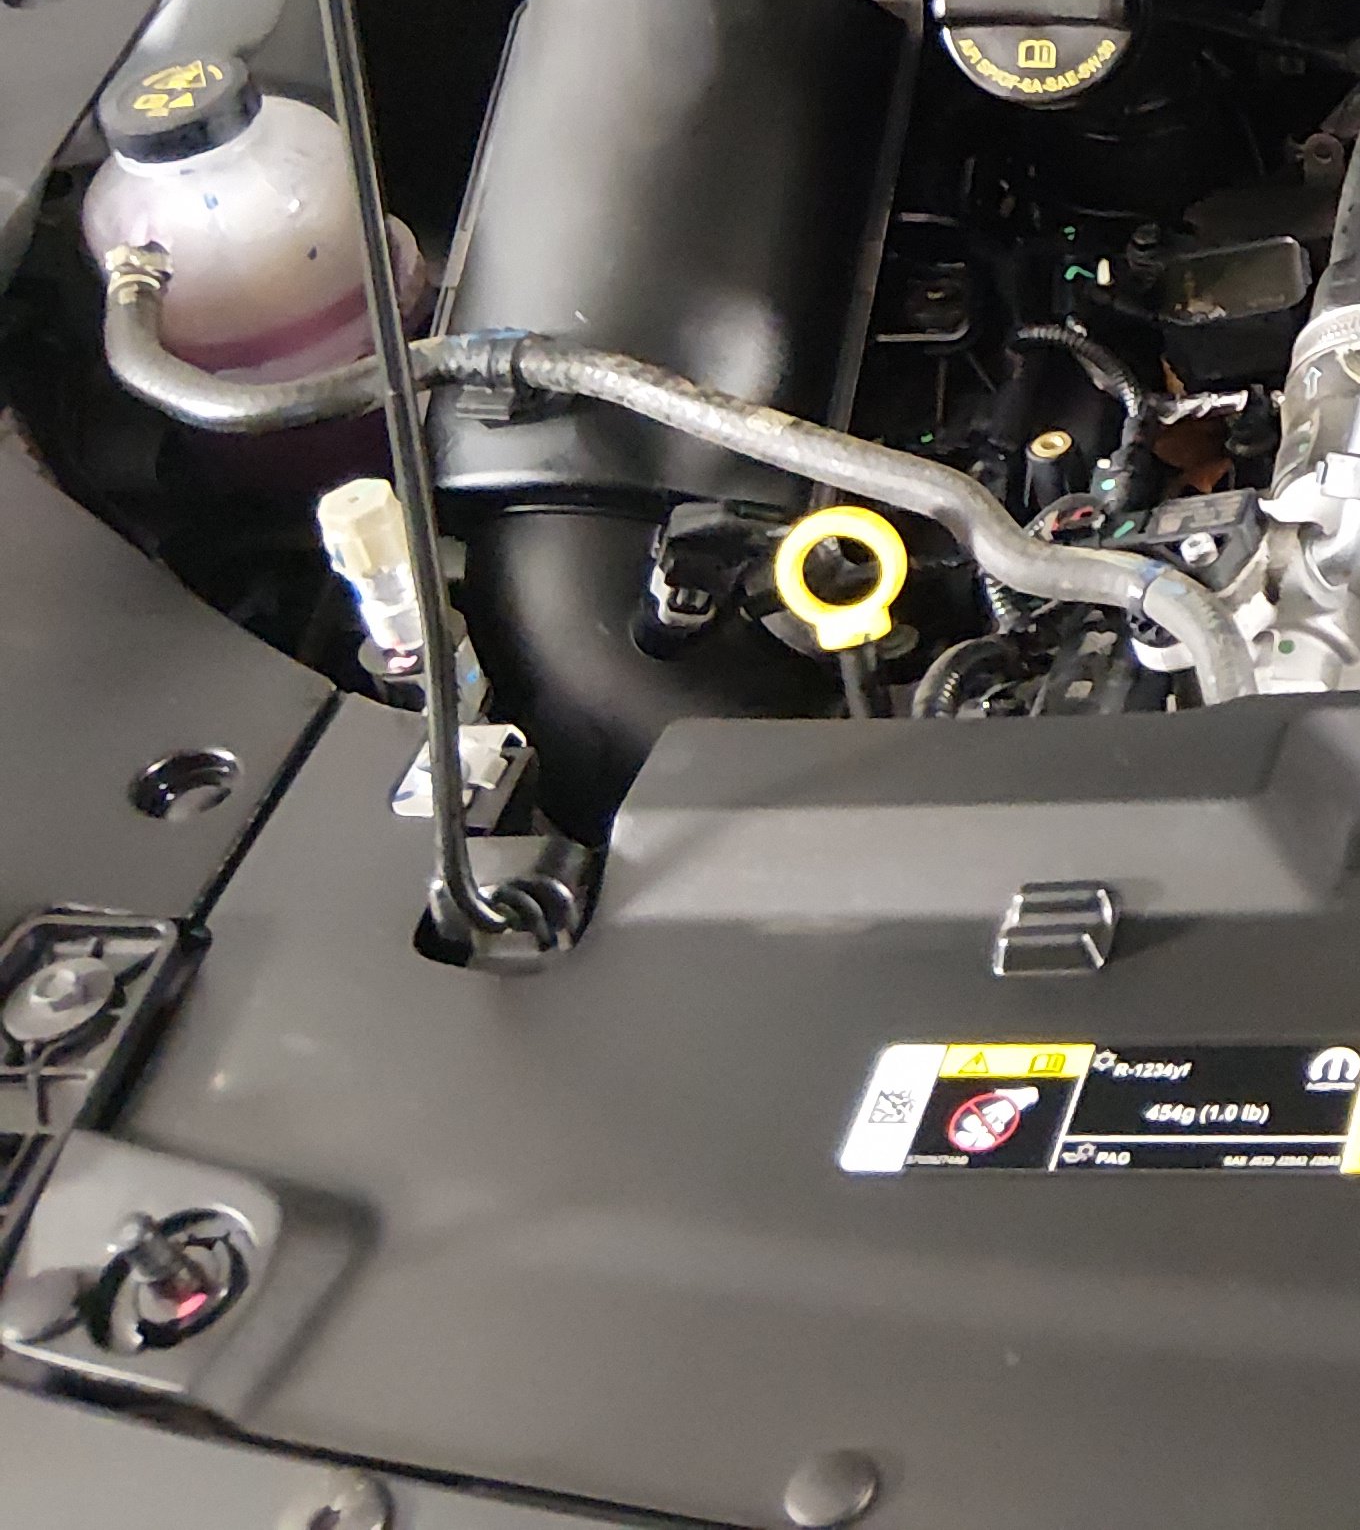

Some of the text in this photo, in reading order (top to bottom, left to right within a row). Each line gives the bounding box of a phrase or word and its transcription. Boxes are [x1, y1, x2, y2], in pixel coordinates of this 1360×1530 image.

[1111, 1061, 1193, 1081] R-1234yf
[1144, 1103, 1270, 1126] 454g (1.0 lb)
